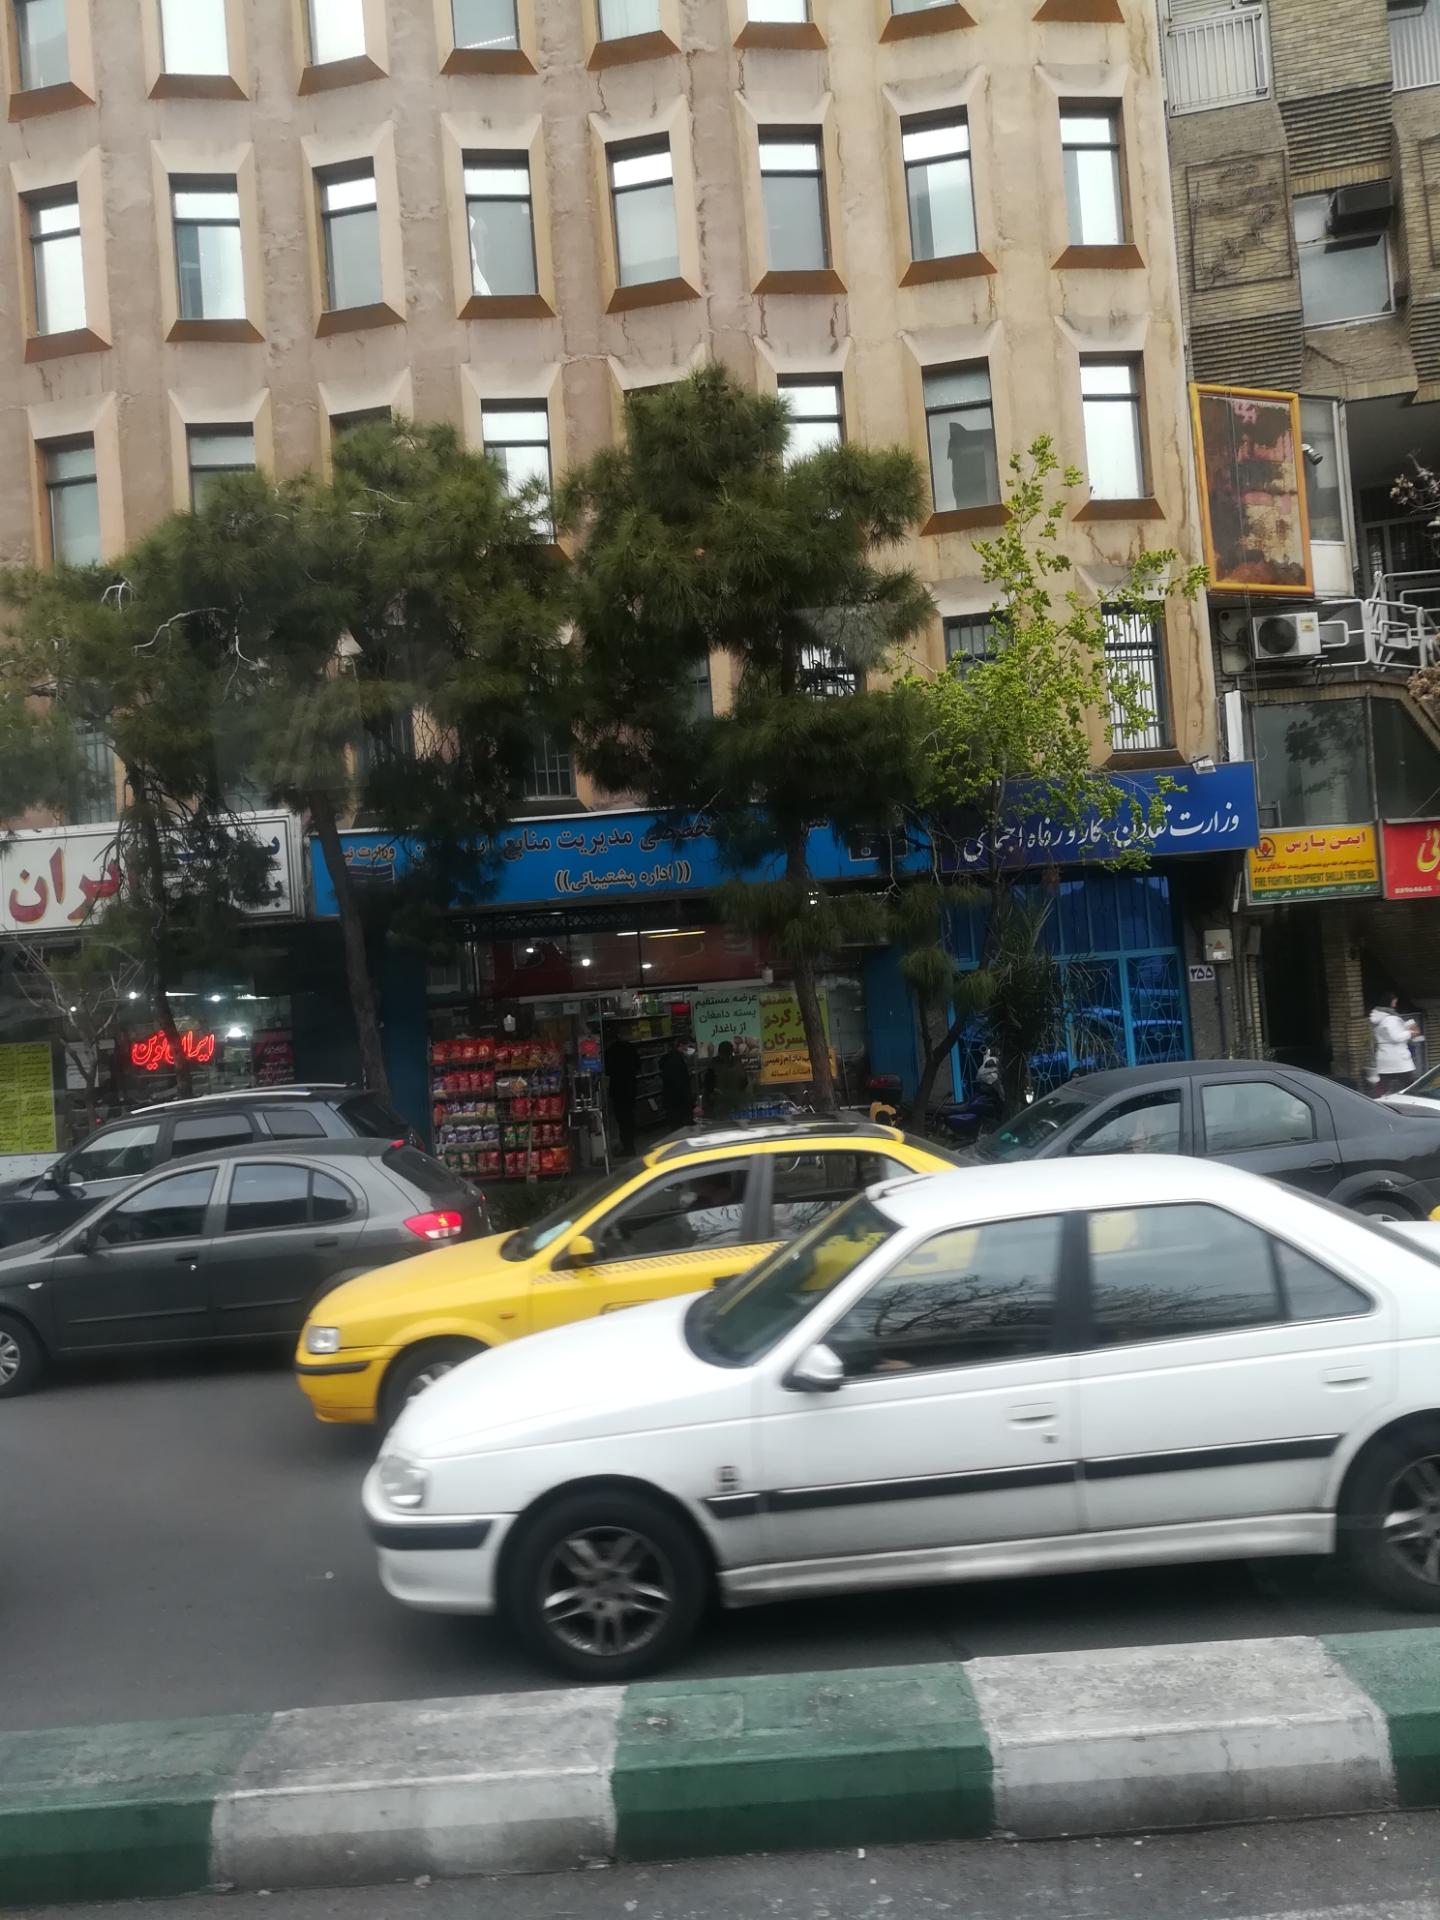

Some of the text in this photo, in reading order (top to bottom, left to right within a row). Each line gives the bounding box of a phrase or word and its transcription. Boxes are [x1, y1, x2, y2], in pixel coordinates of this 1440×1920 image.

[1169, 802, 1240, 836] وزارت
[556, 827, 634, 855] مدیریت
[1027, 817, 1063, 848] رفاه
[1065, 827, 1076, 845] و
[1077, 818, 1103, 844] کار
[356, 843, 396, 862] وزارت
[503, 827, 552, 862] منابع
[1285, 831, 1366, 854] ایمن پارس
[695, 992, 757, 1010] عرضه مستقیم
[732, 1008, 757, 1018] پسته
[763, 1008, 793, 1029] گردو
[711, 1021, 746, 1037] از باغدار
